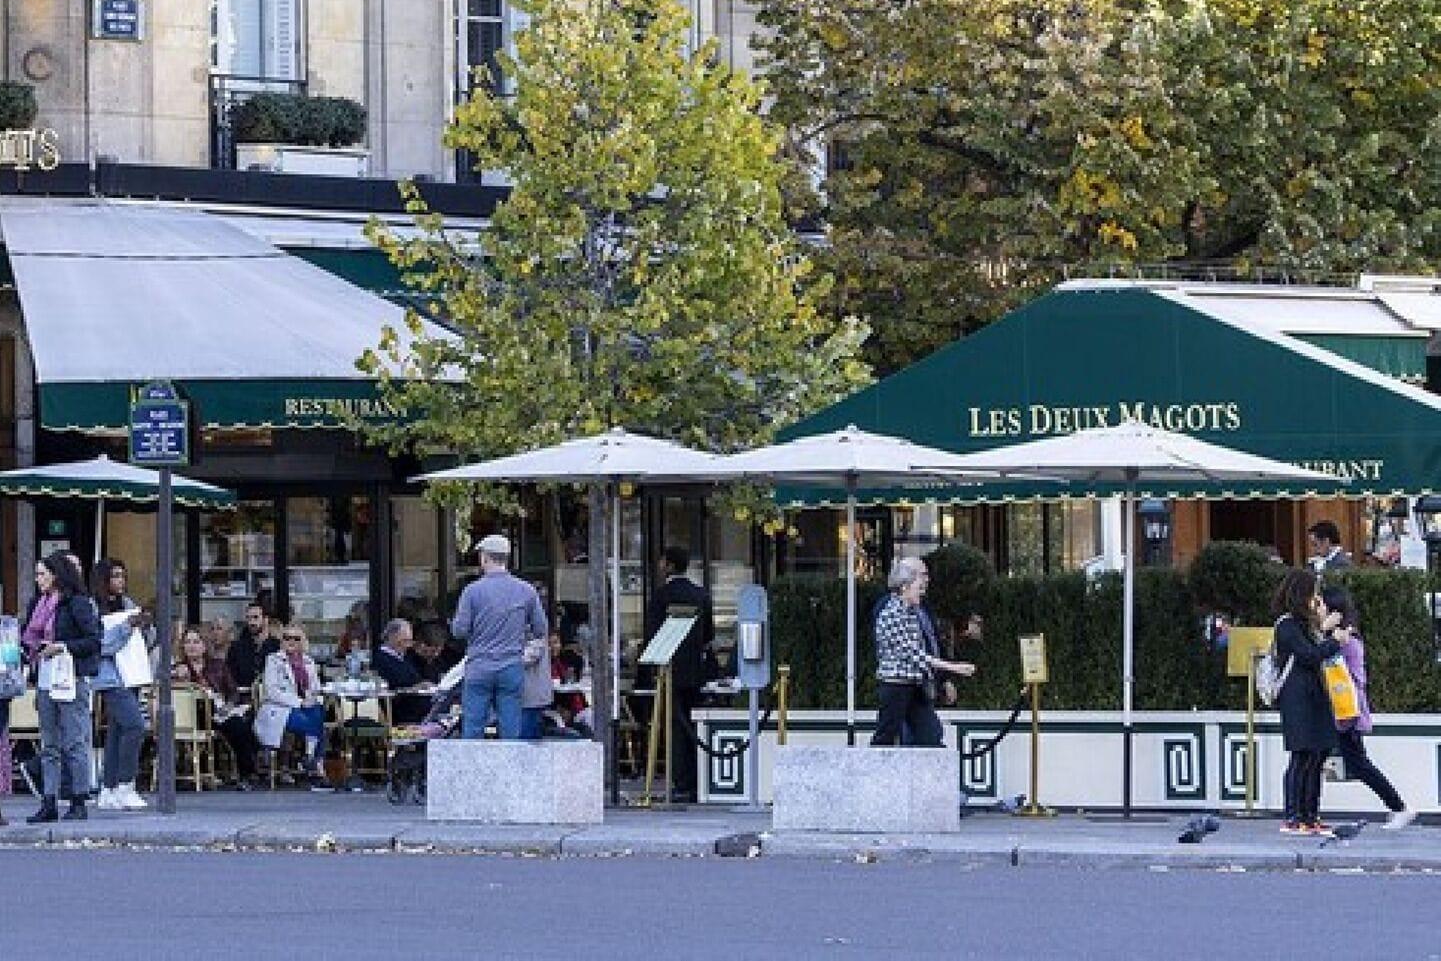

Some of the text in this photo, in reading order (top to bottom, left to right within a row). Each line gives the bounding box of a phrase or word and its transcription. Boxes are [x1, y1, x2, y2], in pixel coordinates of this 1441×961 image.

[968, 401, 1241, 437] LES DEUX MAGOTS
